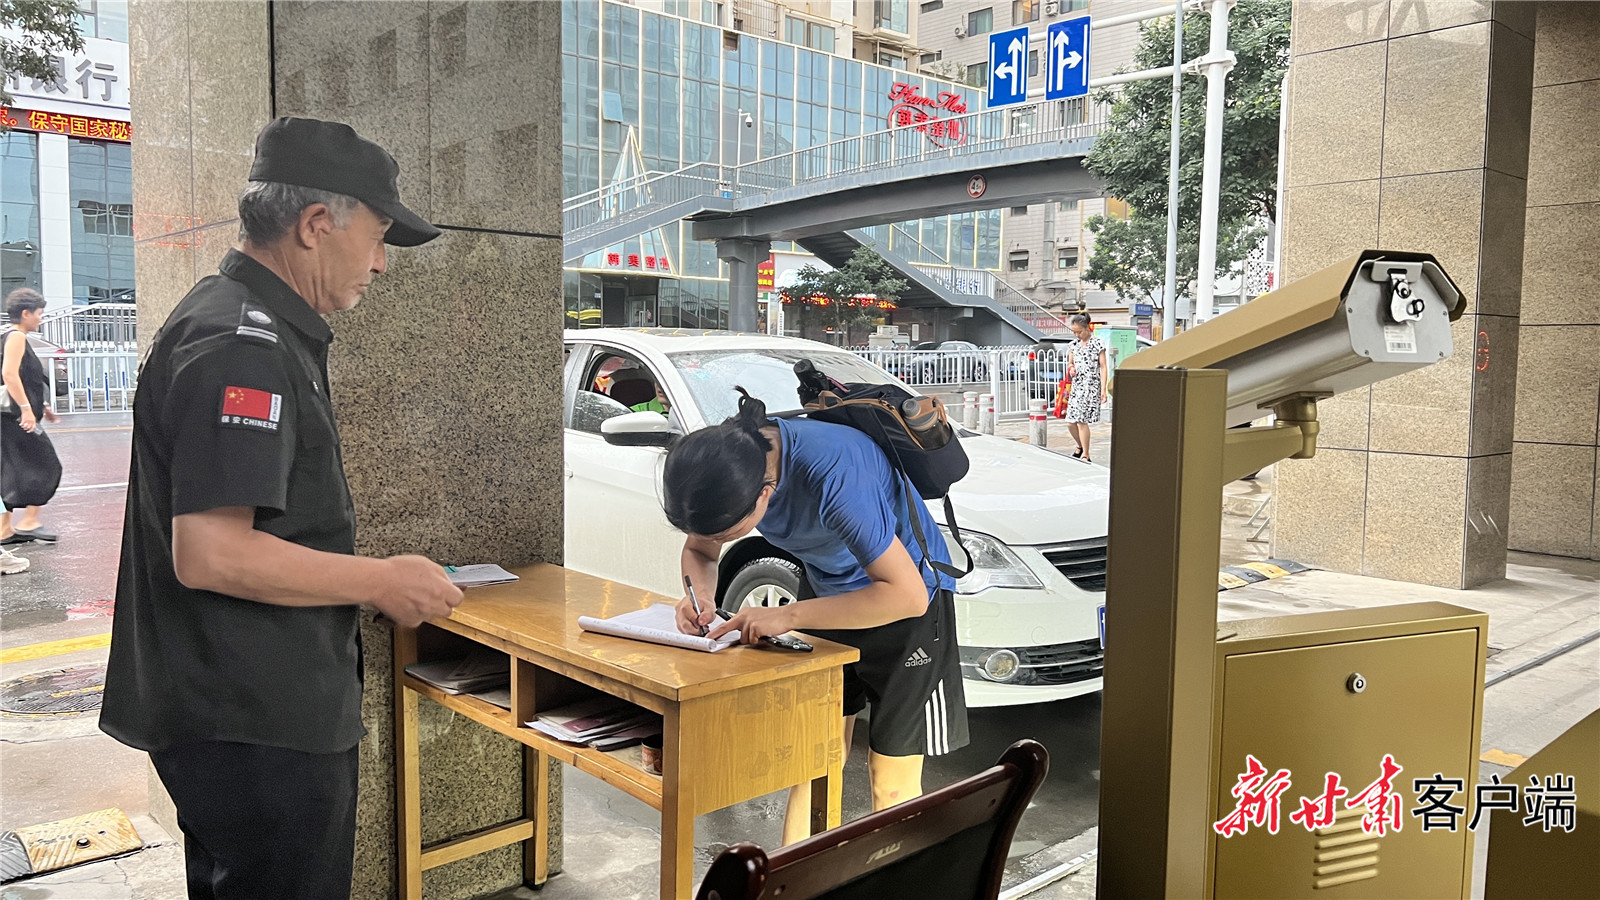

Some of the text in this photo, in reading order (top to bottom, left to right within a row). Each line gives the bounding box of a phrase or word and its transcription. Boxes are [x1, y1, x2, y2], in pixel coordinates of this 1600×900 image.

[12, 55, 118, 101] 银行
[0, 107, 133, 140] 。保守国家秘
[242, 418, 278, 430] CHINESE
[904, 657, 932, 667] adidas
